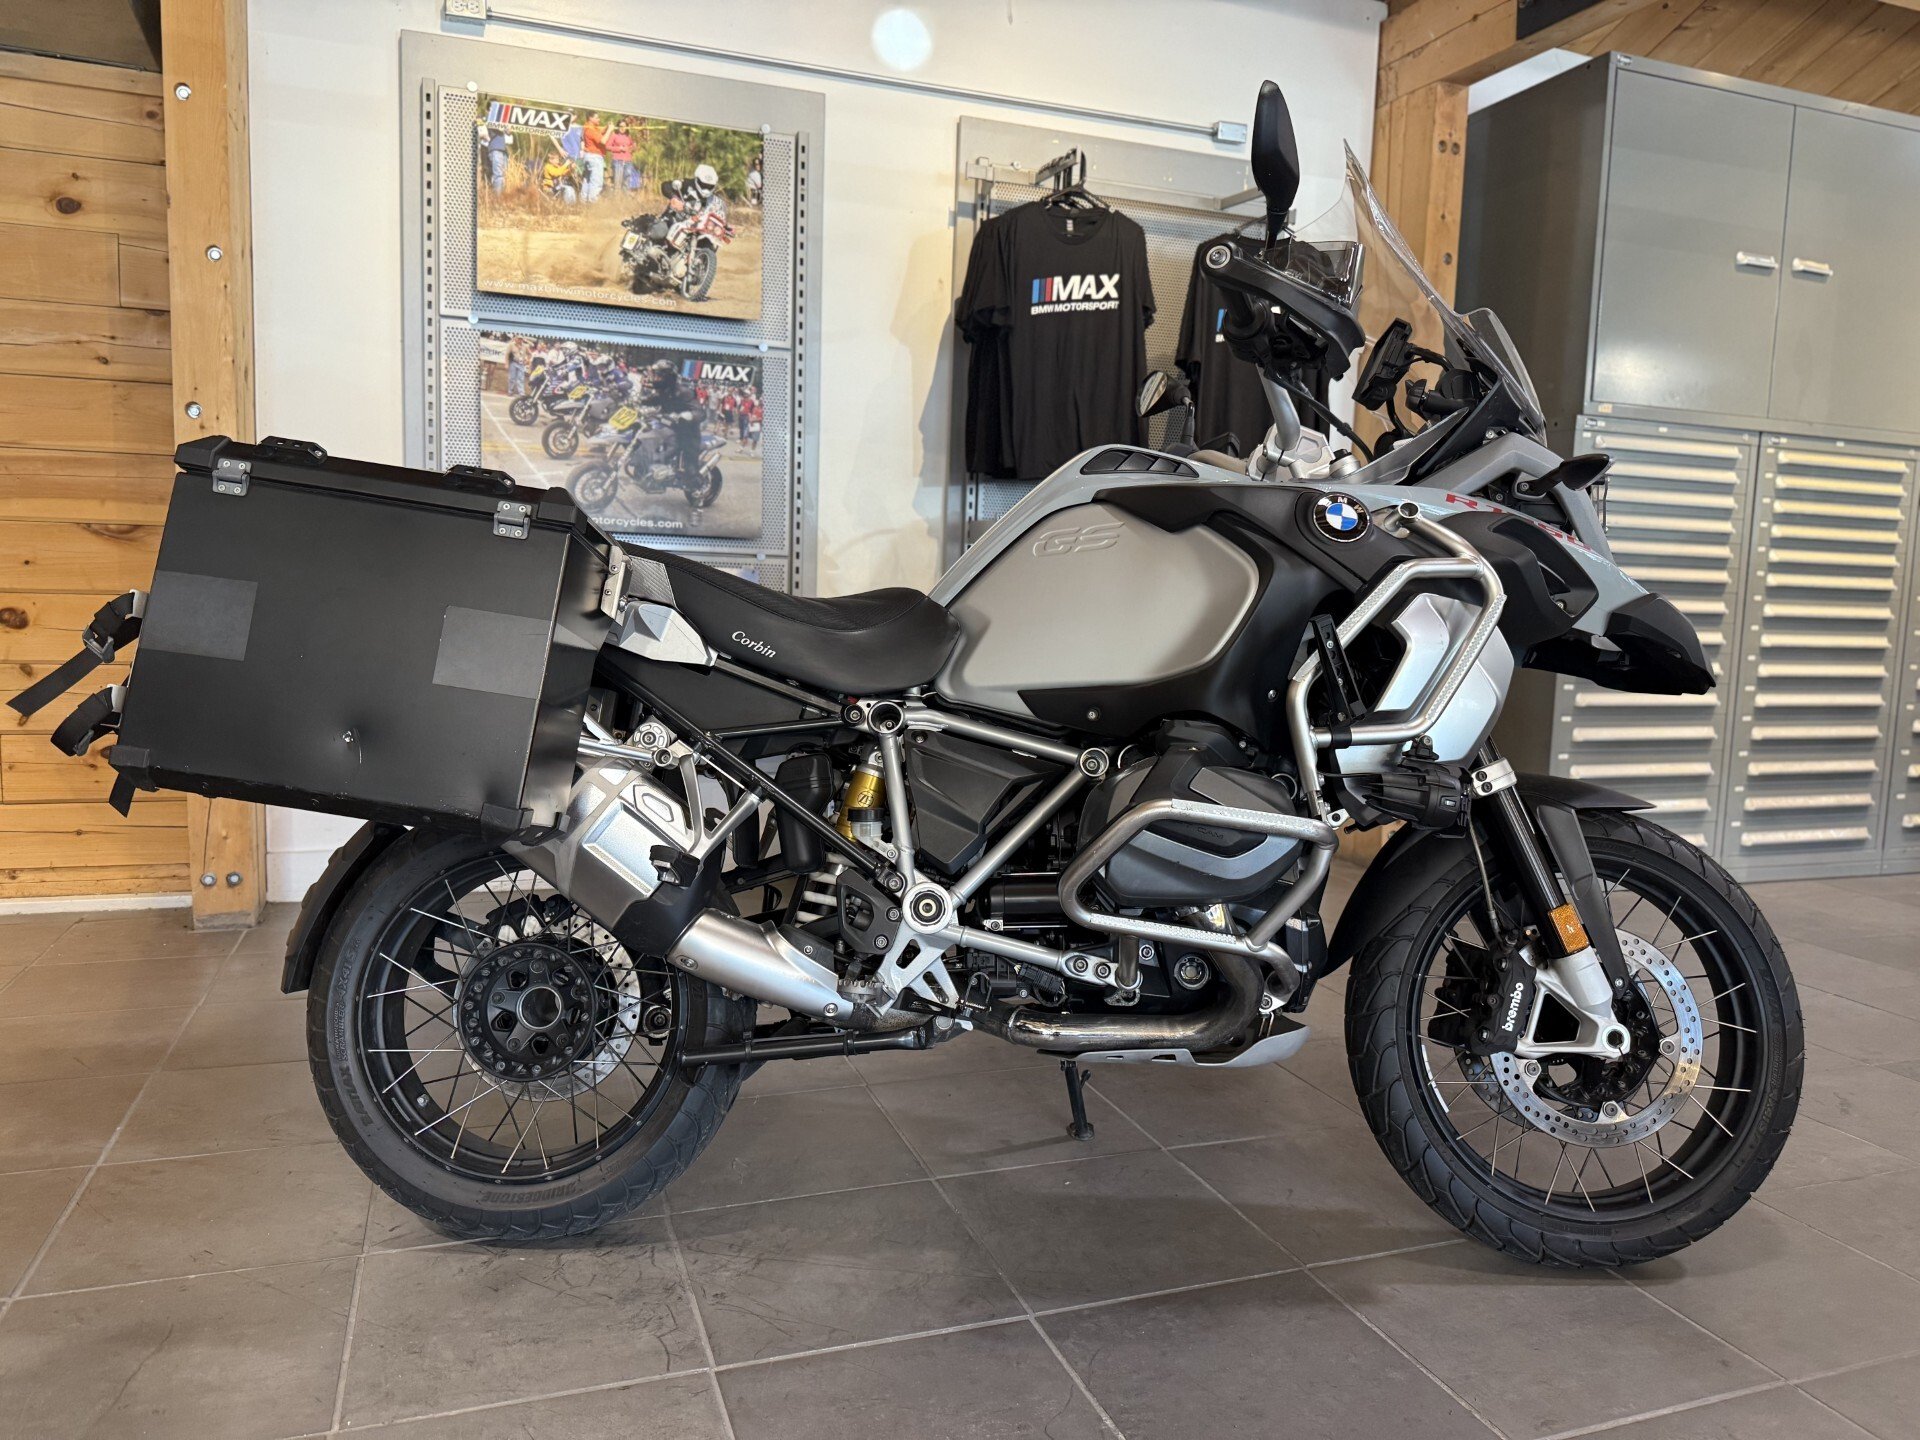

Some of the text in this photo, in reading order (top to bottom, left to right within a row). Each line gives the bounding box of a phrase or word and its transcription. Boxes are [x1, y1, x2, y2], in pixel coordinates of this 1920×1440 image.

[510, 106, 570, 131] MAX
[1051, 273, 1120, 302] MAX
[1030, 300, 1120, 315] BMW MOTORSPORT
[700, 363, 751, 383] MAX
[591, 515, 684, 529] otorcycles.com
[1032, 521, 1125, 557] GS
[731, 630, 777, 658] Corbin
[1501, 982, 1524, 1032] brembo
